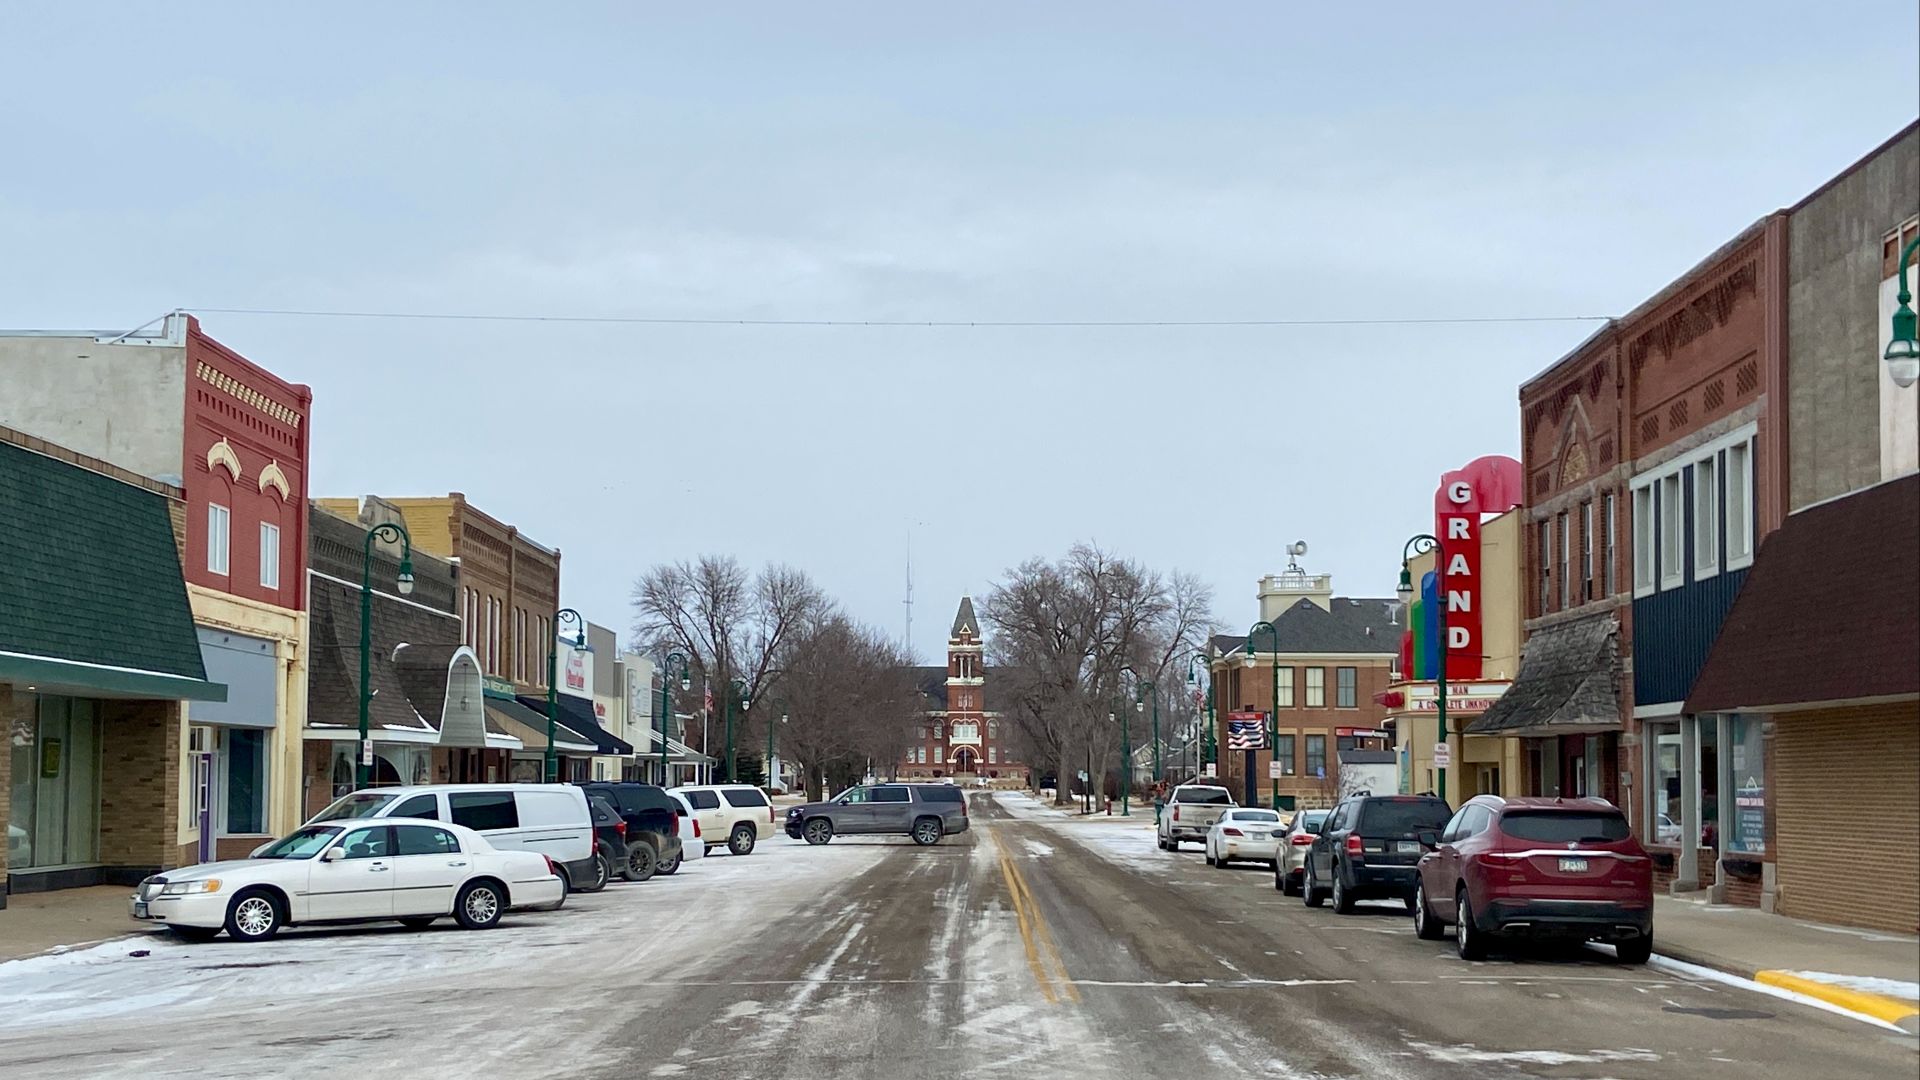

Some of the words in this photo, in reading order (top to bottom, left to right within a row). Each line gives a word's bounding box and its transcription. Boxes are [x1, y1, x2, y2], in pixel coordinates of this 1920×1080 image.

[1448, 481, 1472, 649] GRAND
[1452, 686, 1469, 696] MAN
[1418, 700, 1424, 710] A
[1427, 700, 1462, 709] COLETE
